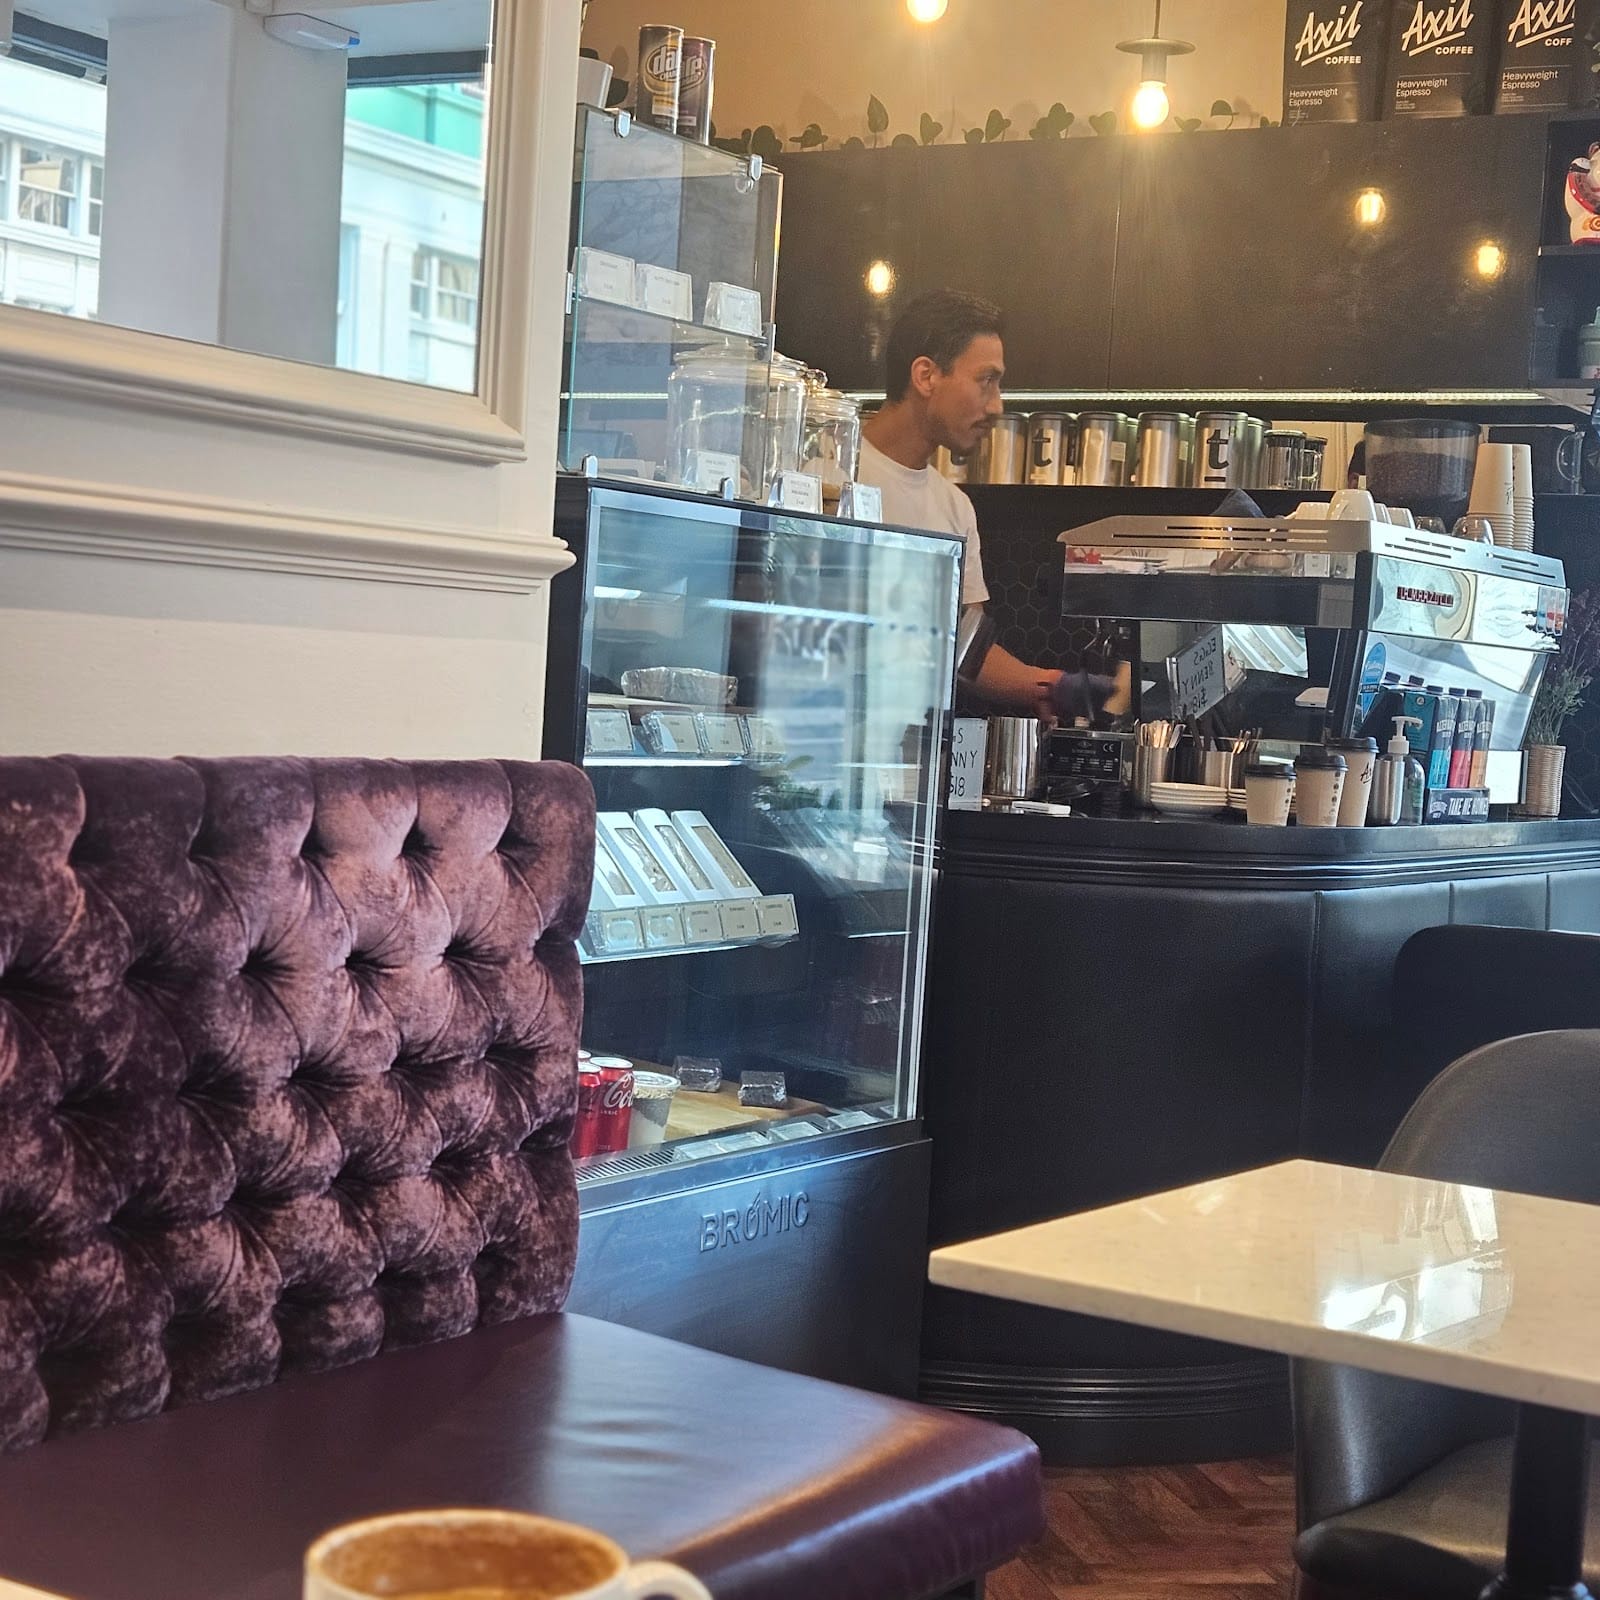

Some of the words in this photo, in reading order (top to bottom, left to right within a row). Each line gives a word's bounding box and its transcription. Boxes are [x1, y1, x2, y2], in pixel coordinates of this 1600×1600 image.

[1401, 0, 1474, 51] Axil
[1295, 1, 1363, 61] Axil
[1544, 38, 1573, 46] COFF
[1435, 46, 1474, 55] COFFEE
[1324, 56, 1362, 65] COFFEE
[1502, 70, 1559, 82] Heavyweight
[1397, 78, 1448, 89] Heavyweight
[1501, 80, 1541, 90] Espresso
[1289, 88, 1338, 98] Heavyweight
[1396, 88, 1431, 98] Espresso
[1289, 98, 1323, 107] Espresso
